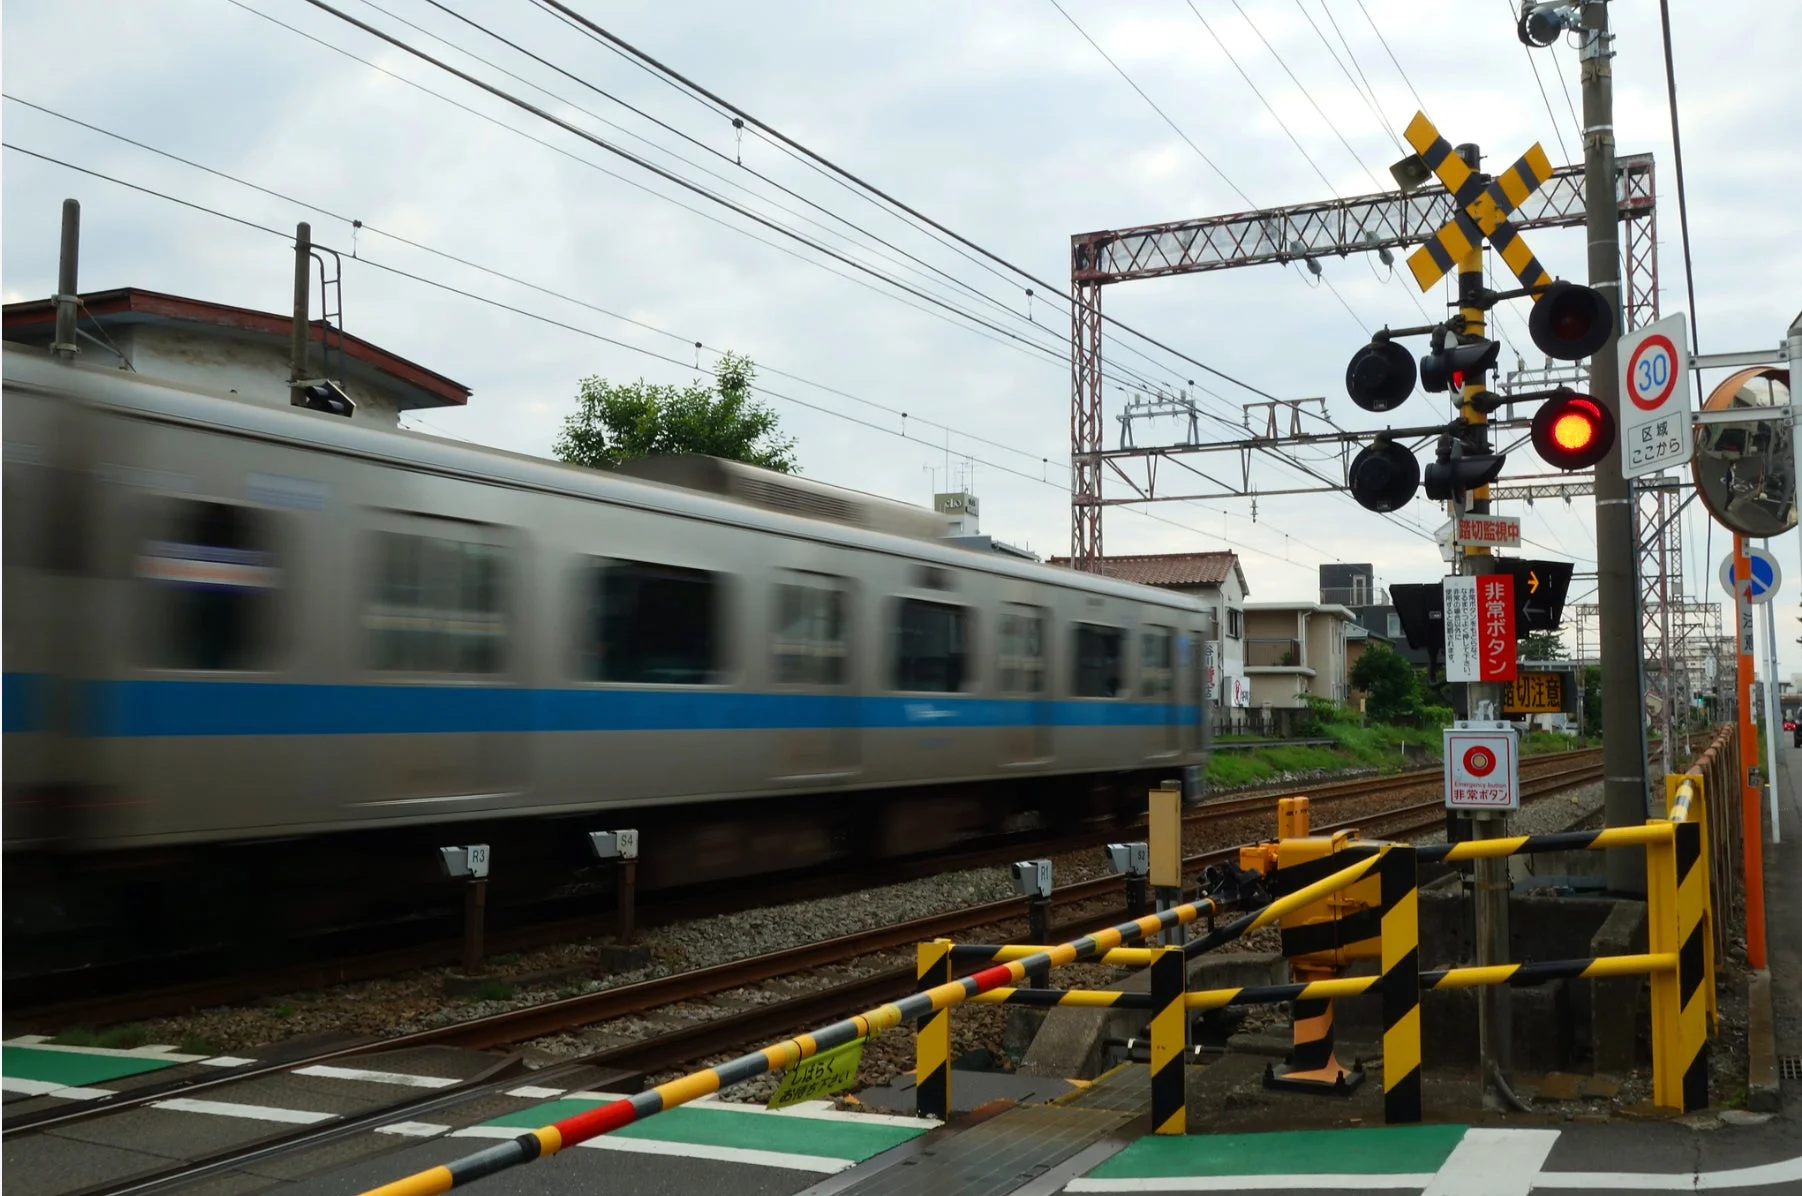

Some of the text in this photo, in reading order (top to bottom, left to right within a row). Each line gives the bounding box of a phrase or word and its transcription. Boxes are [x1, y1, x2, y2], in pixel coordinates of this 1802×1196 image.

[1639, 354, 1666, 391] 30
[1642, 422, 1668, 442] 区域
[1631, 438, 1680, 465] ここから
[1458, 519, 1520, 542] 踏切監視中
[1485, 582, 1506, 674] 非常ボタン
[1453, 789, 1508, 801] 非常ボタン
[620, 834, 633, 848] S4
[472, 850, 485, 863] R3
[791, 1056, 835, 1086] しばらく
